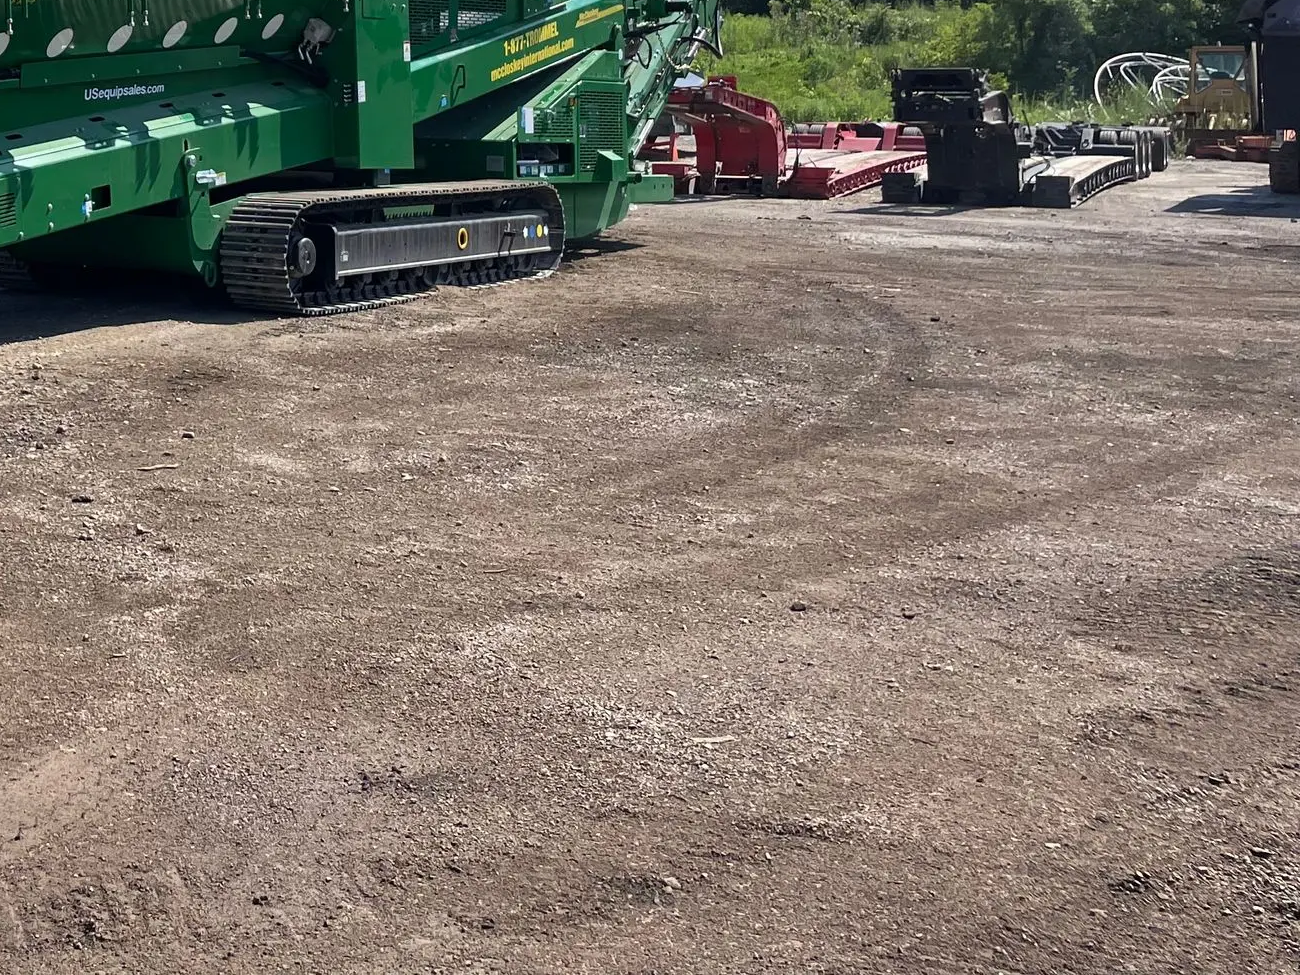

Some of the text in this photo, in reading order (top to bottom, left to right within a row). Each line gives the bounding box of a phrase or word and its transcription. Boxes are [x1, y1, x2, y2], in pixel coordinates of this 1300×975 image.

[503, 21, 559, 56] 1-877-TROMMEL
[490, 37, 575, 82] mccloskeyinternational.com
[84, 84, 165, 101] USequipsales.com
